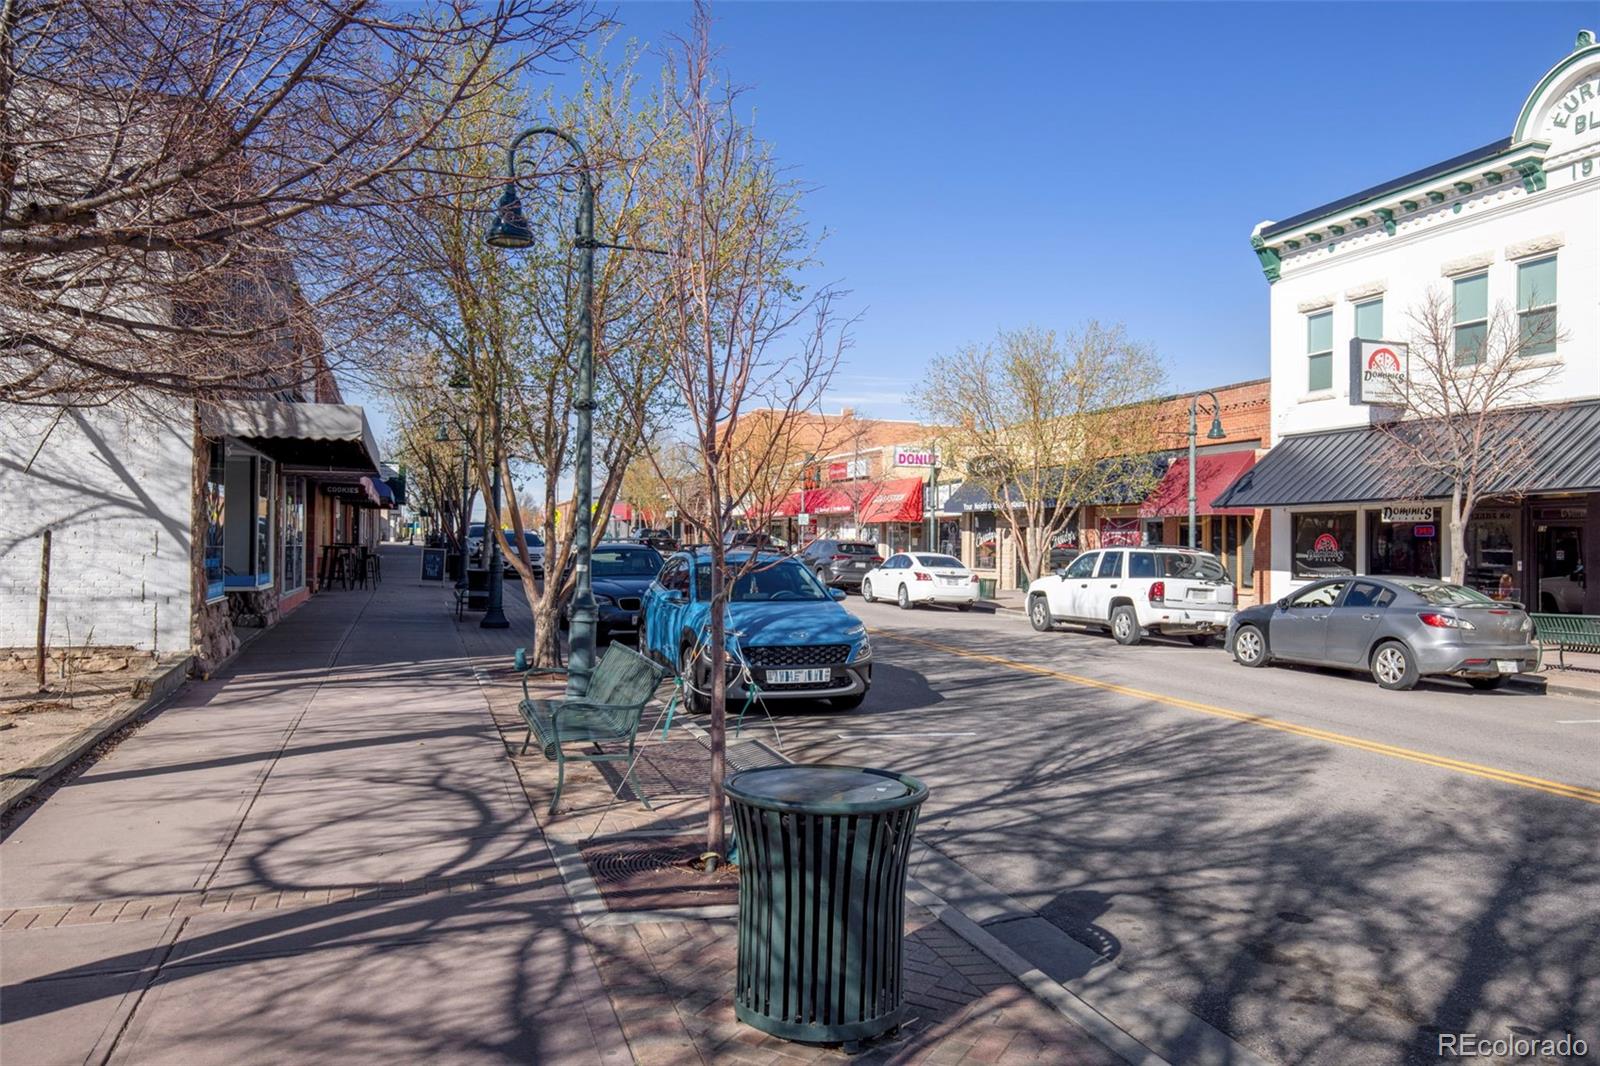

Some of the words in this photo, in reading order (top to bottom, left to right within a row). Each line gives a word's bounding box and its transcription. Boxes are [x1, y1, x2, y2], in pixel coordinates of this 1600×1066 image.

[1575, 111, 1600, 135] BL
[898, 453, 940, 465] DONU
[327, 486, 359, 494] COOKIES
